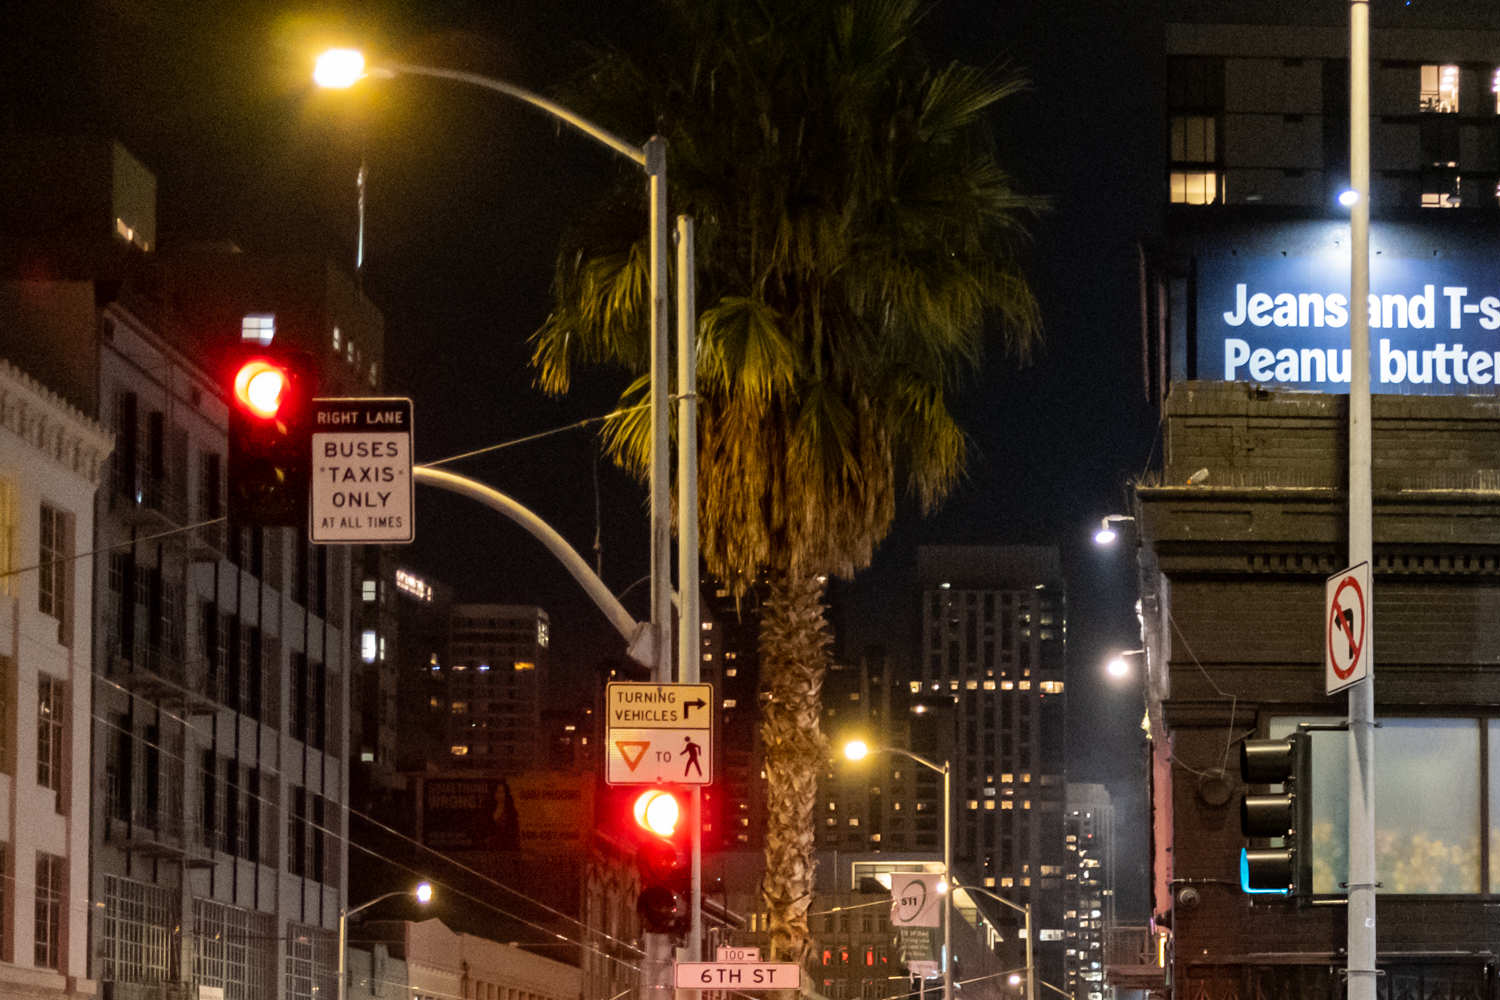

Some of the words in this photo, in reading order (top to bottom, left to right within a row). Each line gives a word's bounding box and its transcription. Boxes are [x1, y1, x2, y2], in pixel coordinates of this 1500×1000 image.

[1223, 283, 1349, 328] Jeans
[1368, 284, 1435, 329] and
[1224, 338, 1352, 383] Peanu
[317, 411, 359, 424] RIGHT
[366, 411, 403, 424] LANE
[324, 441, 399, 458] BUSES
[328, 466, 394, 483] TAXIS
[332, 491, 392, 508] ONLY
[321, 516, 335, 529] AT
[340, 516, 362, 529] ALL
[368, 516, 402, 529] TIMES
[617, 691, 676, 704] TURNING
[615, 709, 678, 722] VEHICLES
[655, 751, 672, 763] TO
[901, 898, 917, 906] 511
[724, 950, 744, 960] 100
[700, 968, 741, 984] 6TH
[753, 968, 777, 984] ST
